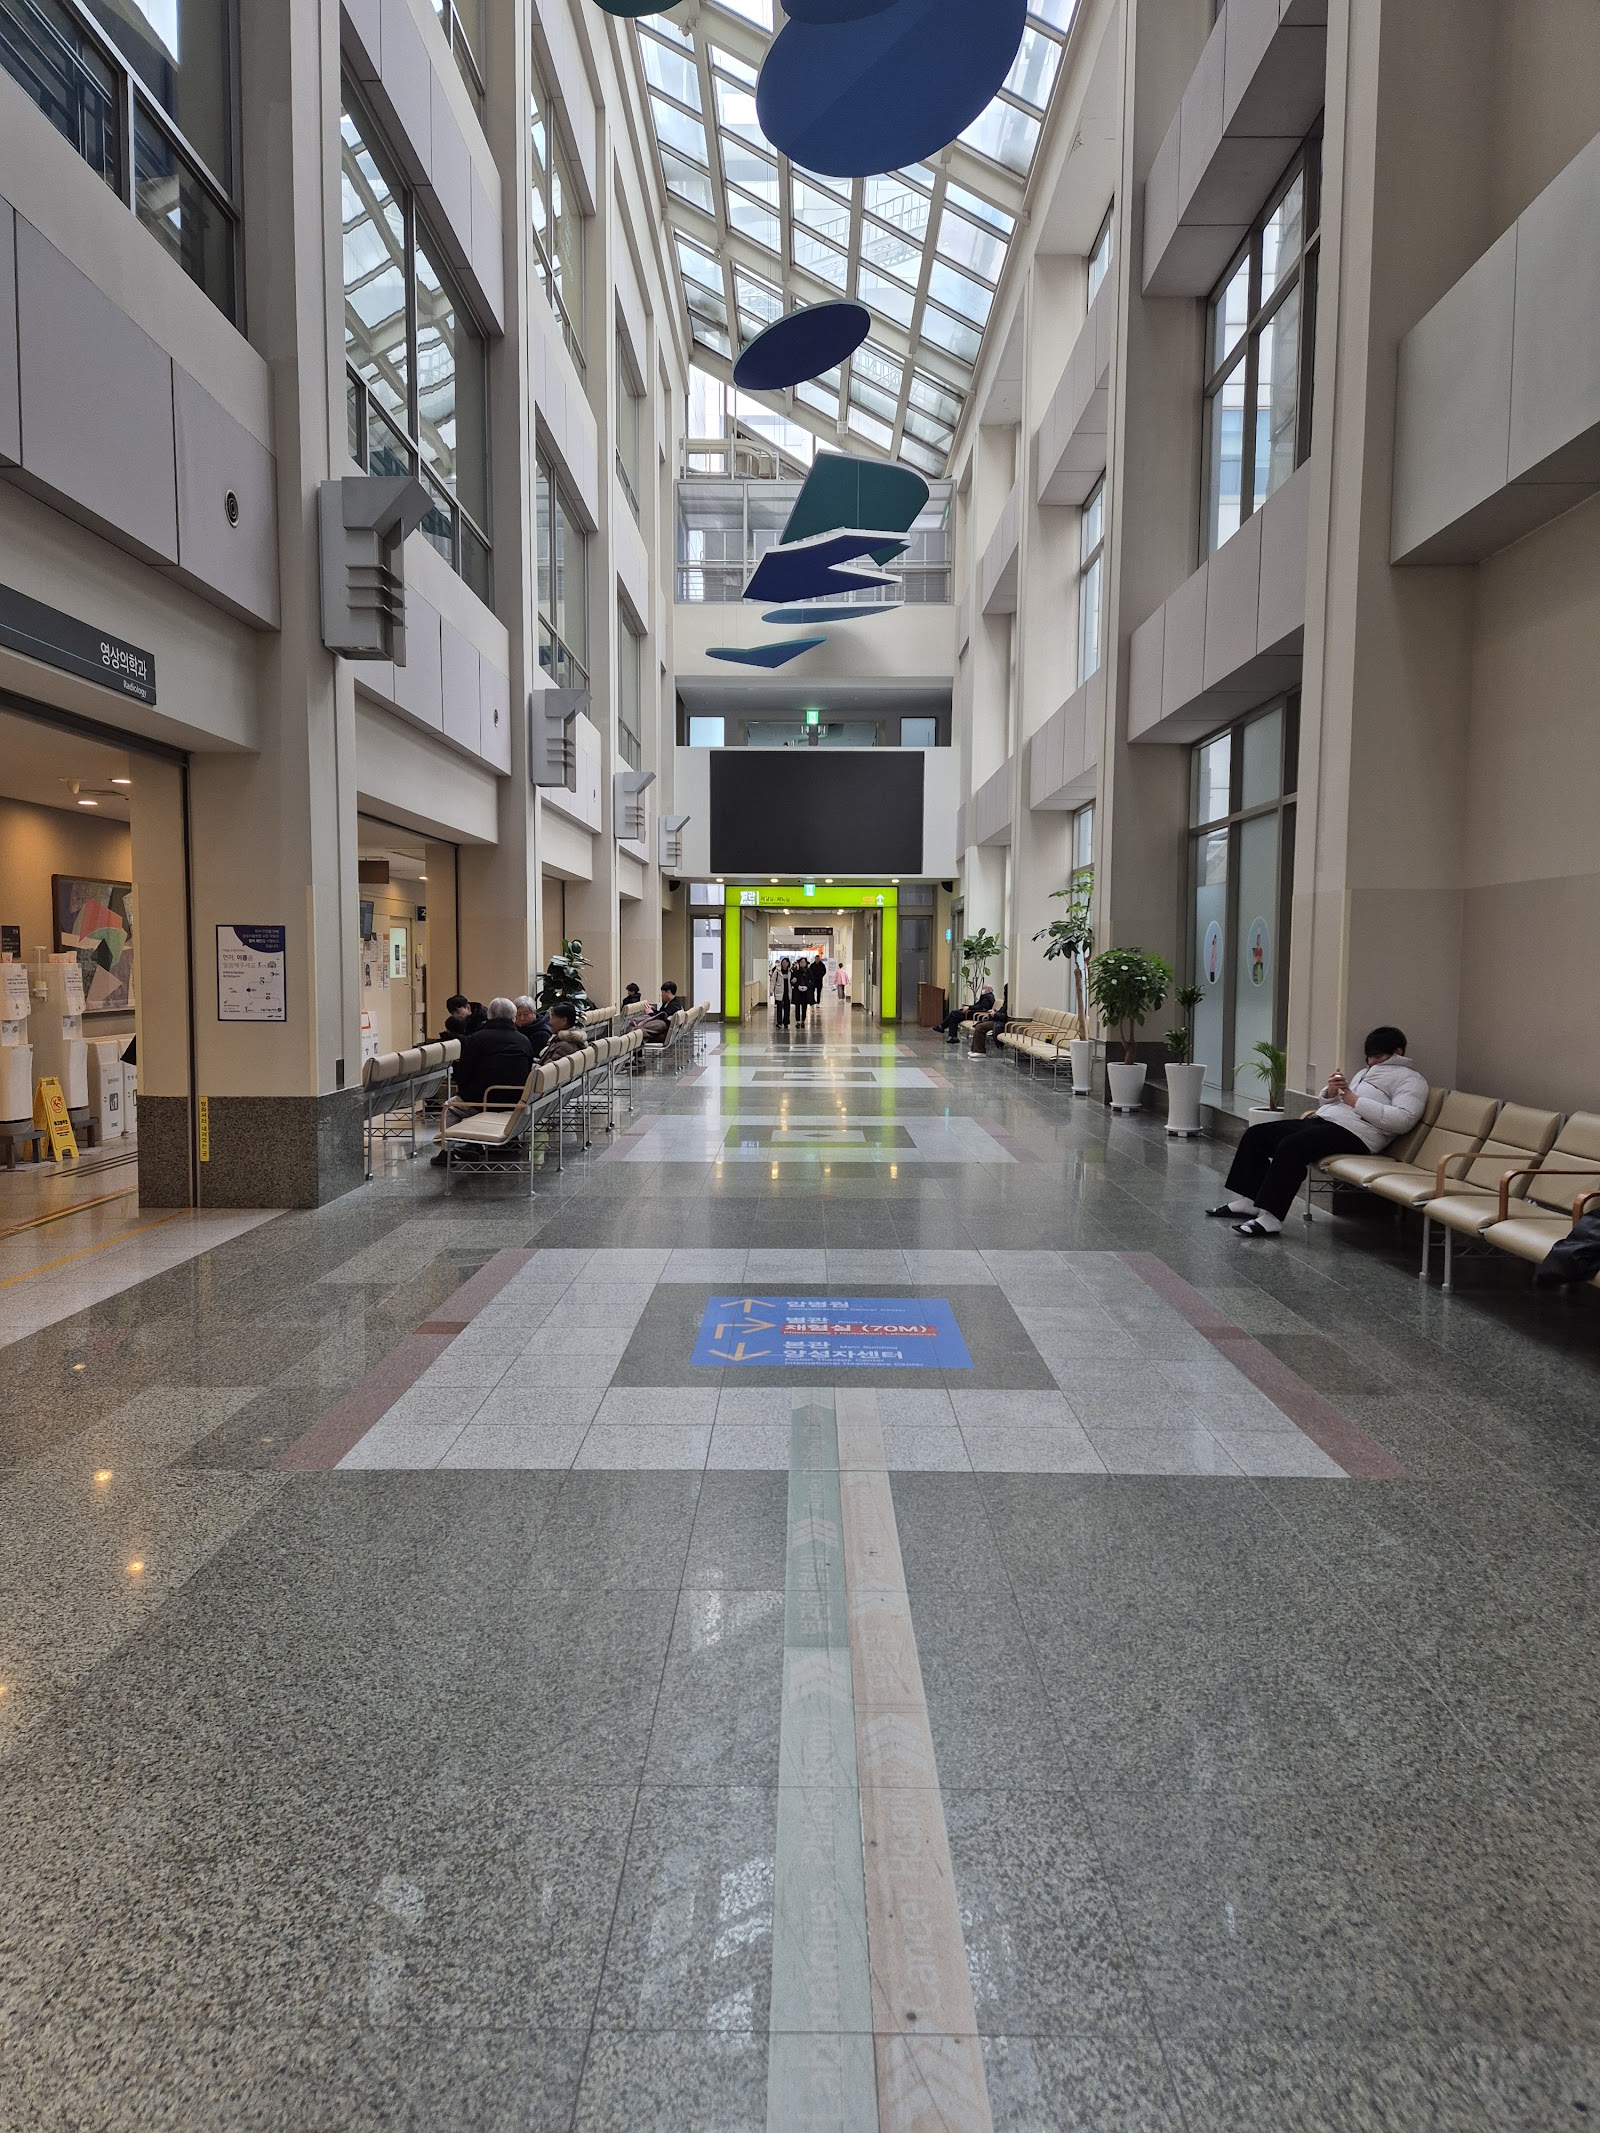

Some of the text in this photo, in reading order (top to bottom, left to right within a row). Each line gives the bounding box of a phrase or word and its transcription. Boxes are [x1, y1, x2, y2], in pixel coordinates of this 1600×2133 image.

[100, 641, 147, 681] 영상의학과
[123, 679, 147, 698] Radiology
[786, 1301, 849, 1309] 암병원
[784, 1324, 927, 1333] 채혈실 (70M)
[783, 1341, 831, 1349] 본관
[783, 1350, 903, 1360] 양성자센터
